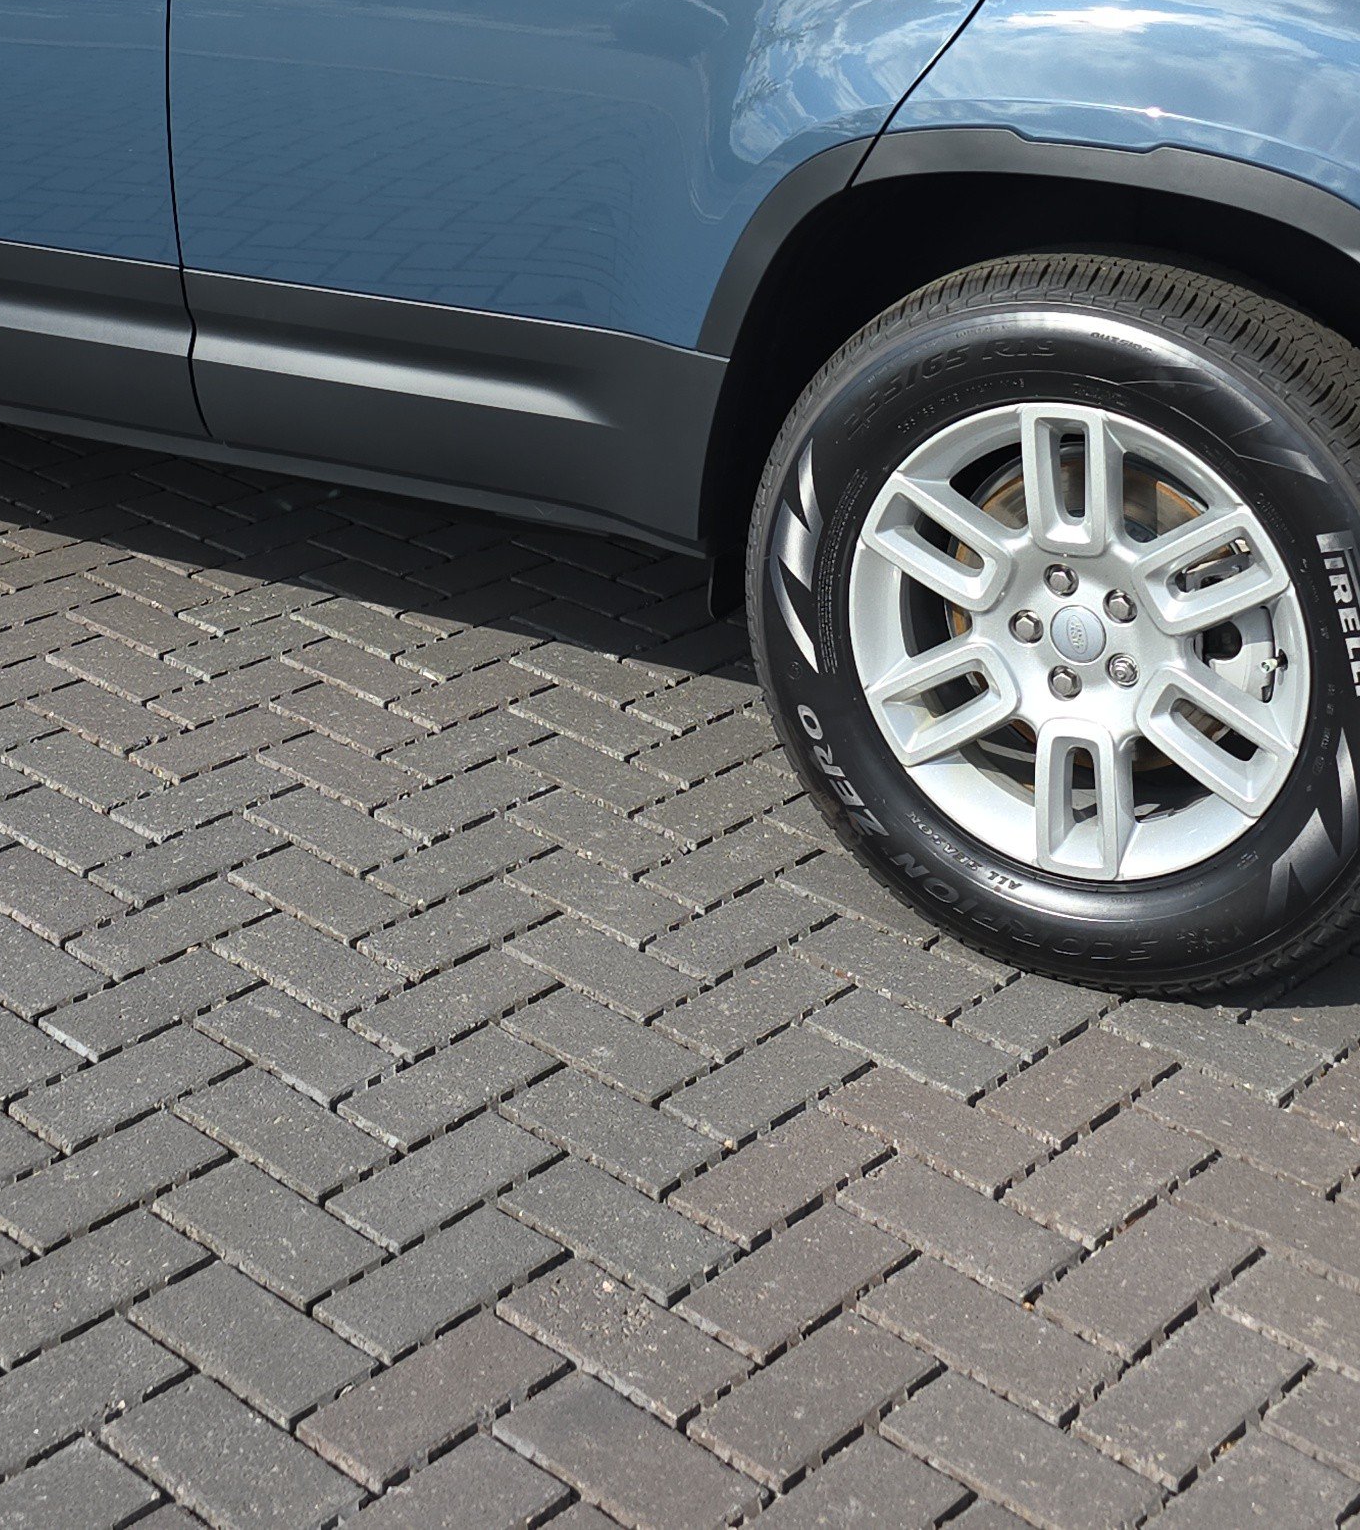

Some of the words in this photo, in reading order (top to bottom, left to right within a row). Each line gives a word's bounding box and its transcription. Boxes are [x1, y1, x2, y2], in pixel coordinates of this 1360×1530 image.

[796, 703, 890, 838] ZERO
[903, 810, 983, 872] SEASON
[987, 869, 1024, 890] ALL
